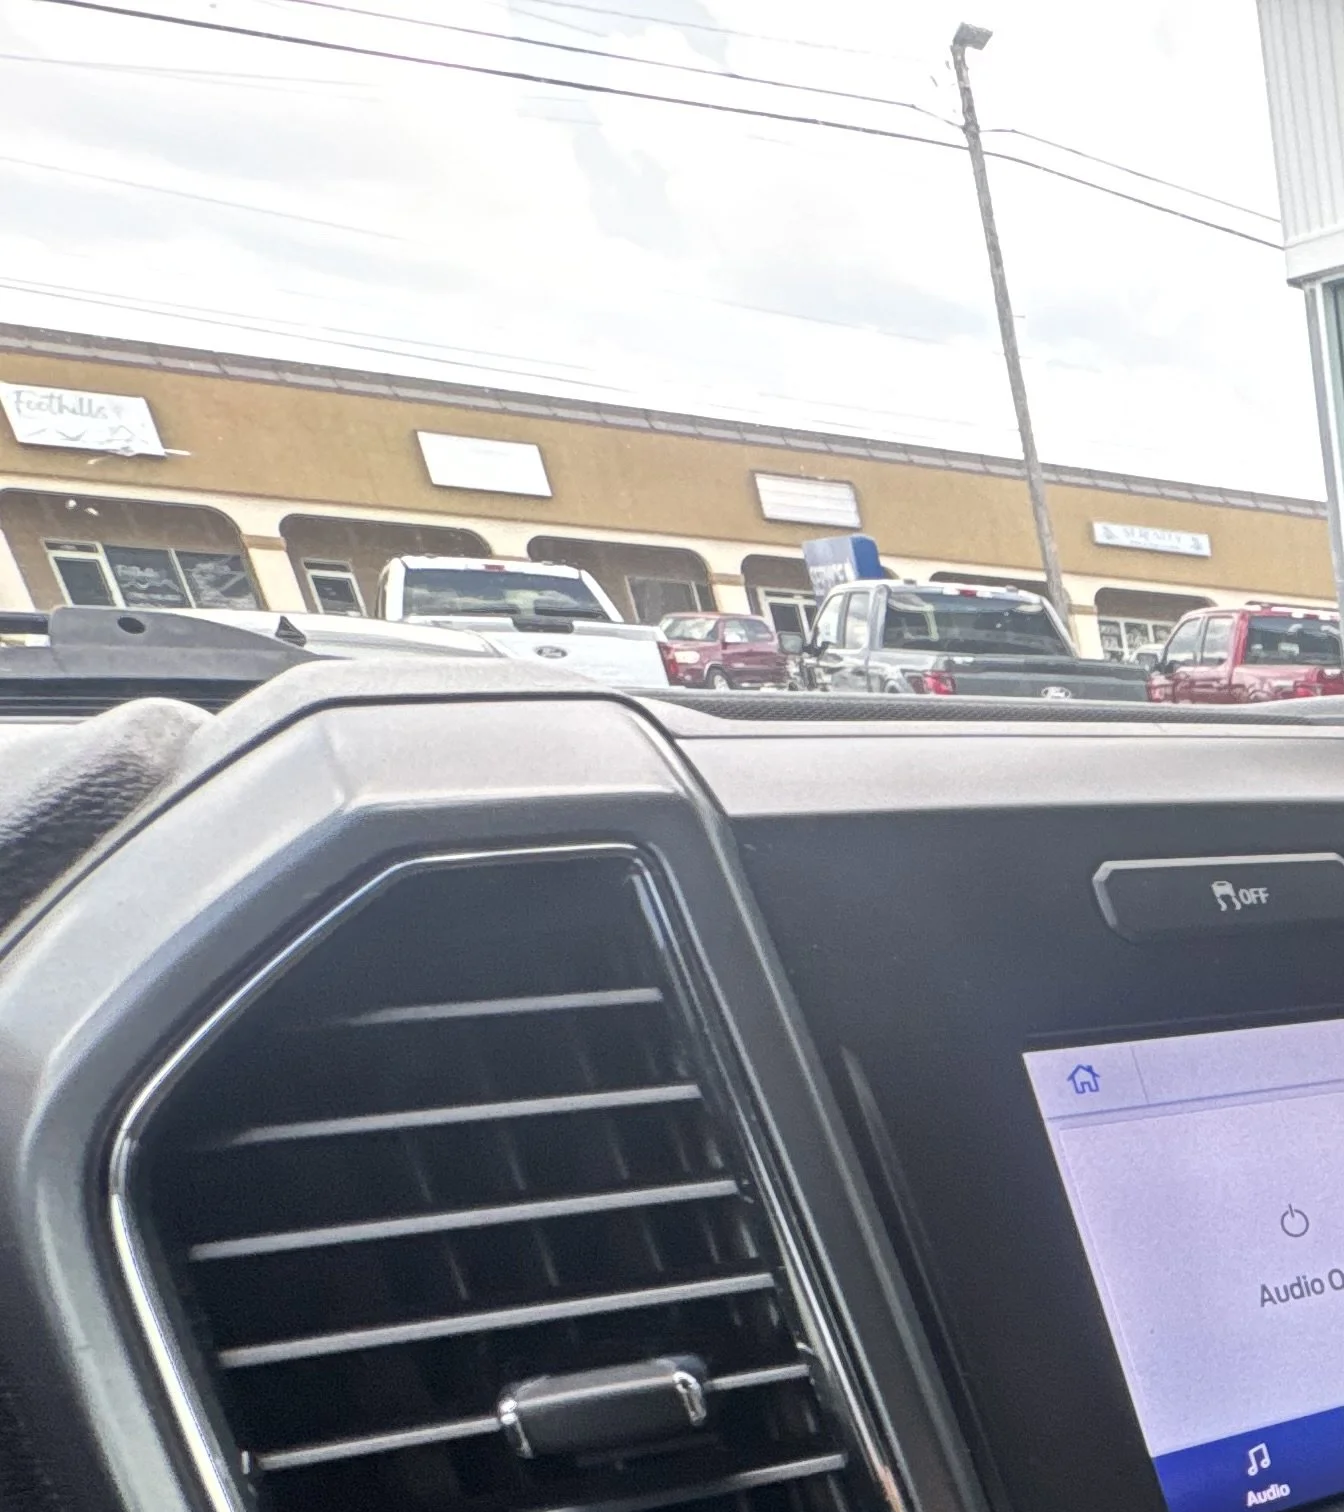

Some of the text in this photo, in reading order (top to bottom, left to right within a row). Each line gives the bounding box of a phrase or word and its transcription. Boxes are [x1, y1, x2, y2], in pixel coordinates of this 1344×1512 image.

[14, 390, 108, 419] Foothills
[1238, 886, 1269, 906] OFF
[1259, 1271, 1326, 1309] Audio
[1246, 1482, 1291, 1508] Audio
